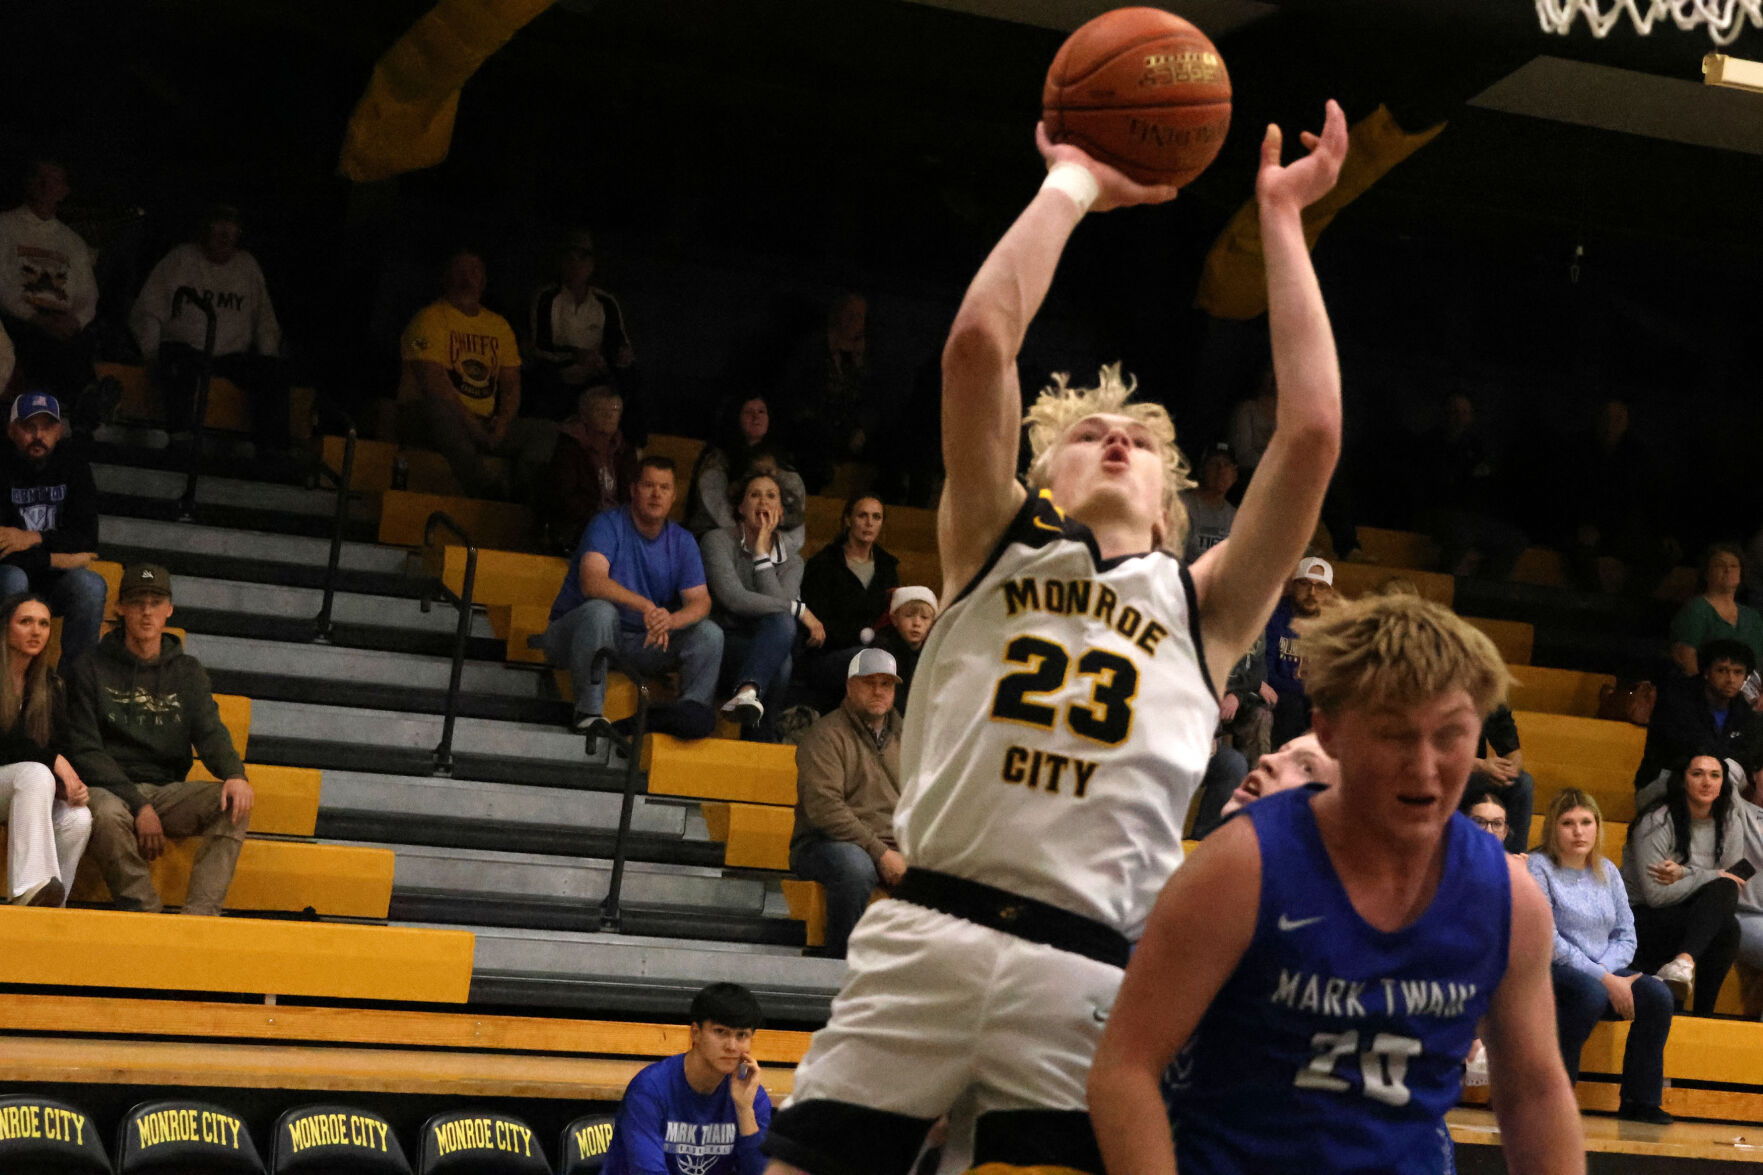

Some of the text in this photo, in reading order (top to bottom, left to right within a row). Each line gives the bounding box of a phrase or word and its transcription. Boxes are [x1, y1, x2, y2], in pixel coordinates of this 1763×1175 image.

[1003, 577, 1169, 658] MONROE
[991, 634, 1140, 747] 23
[1002, 745, 1099, 798] CITY
[1271, 968, 1367, 1018] MARK
[1294, 1029, 1422, 1107] 20
[44, 1107, 85, 1145] CITY
[136, 1109, 240, 1149] MONROE CITY
[289, 1114, 388, 1152] MONROE CITY
[435, 1118, 531, 1157] MONROE CITY
[665, 1121, 698, 1145] MRK
